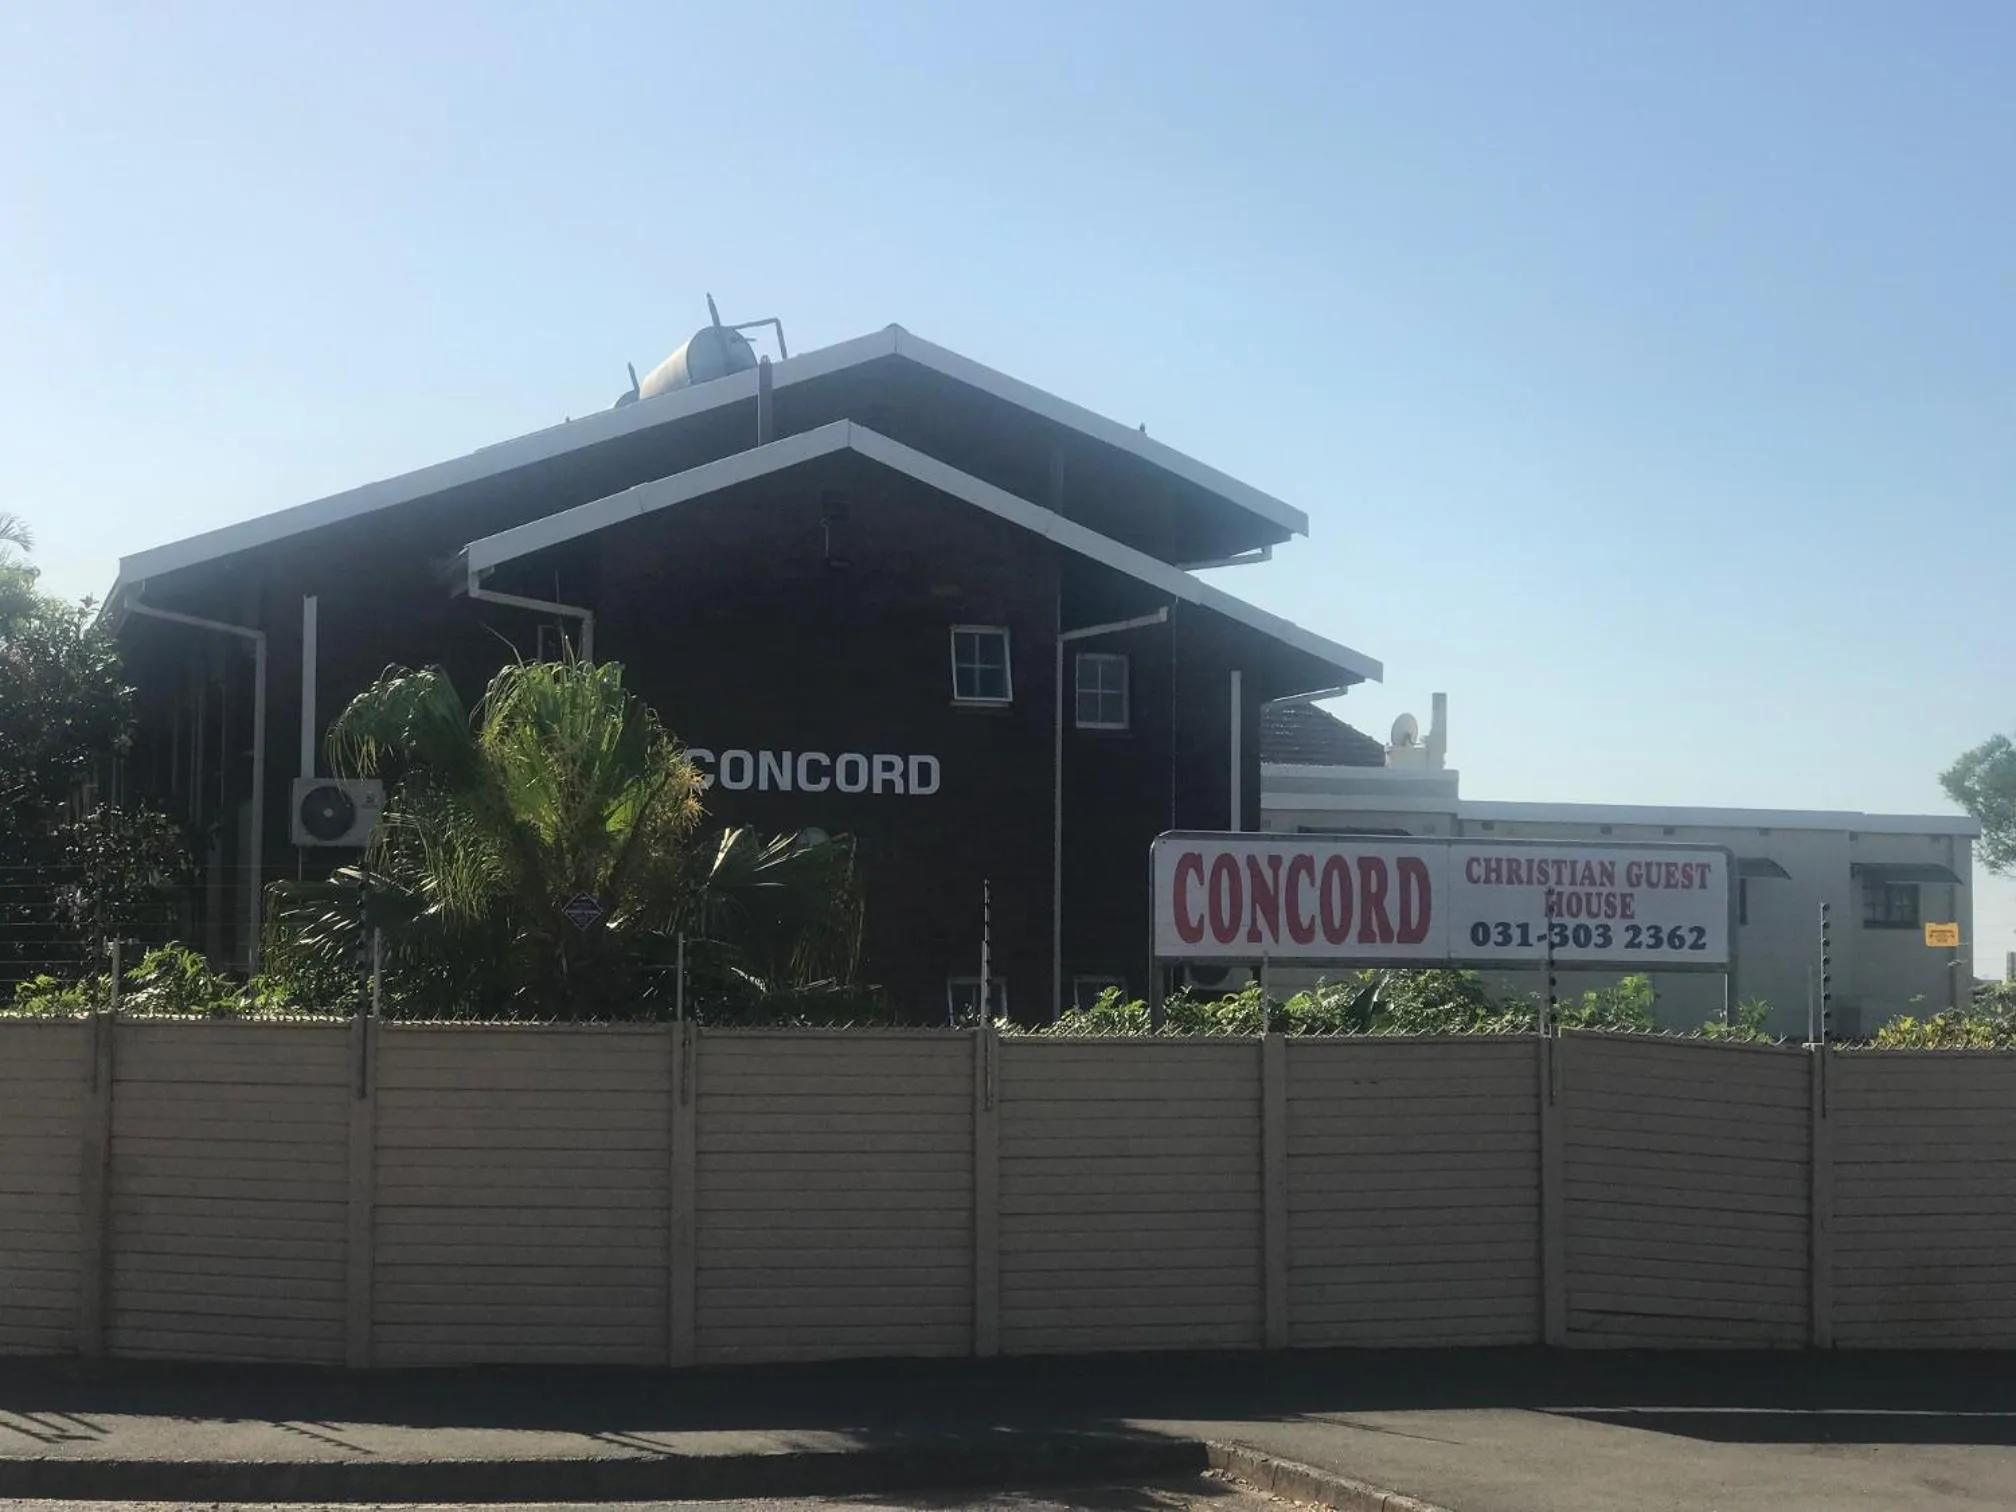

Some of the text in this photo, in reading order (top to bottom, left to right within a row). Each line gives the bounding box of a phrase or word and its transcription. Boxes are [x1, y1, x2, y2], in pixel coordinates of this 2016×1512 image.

[1465, 857, 1712, 889] CHRISTIAN GUEST
[1173, 852, 1432, 945] CONCORD
[1544, 891, 1636, 919] HOUSE
[1470, 922, 1707, 950] 031-303 2362
